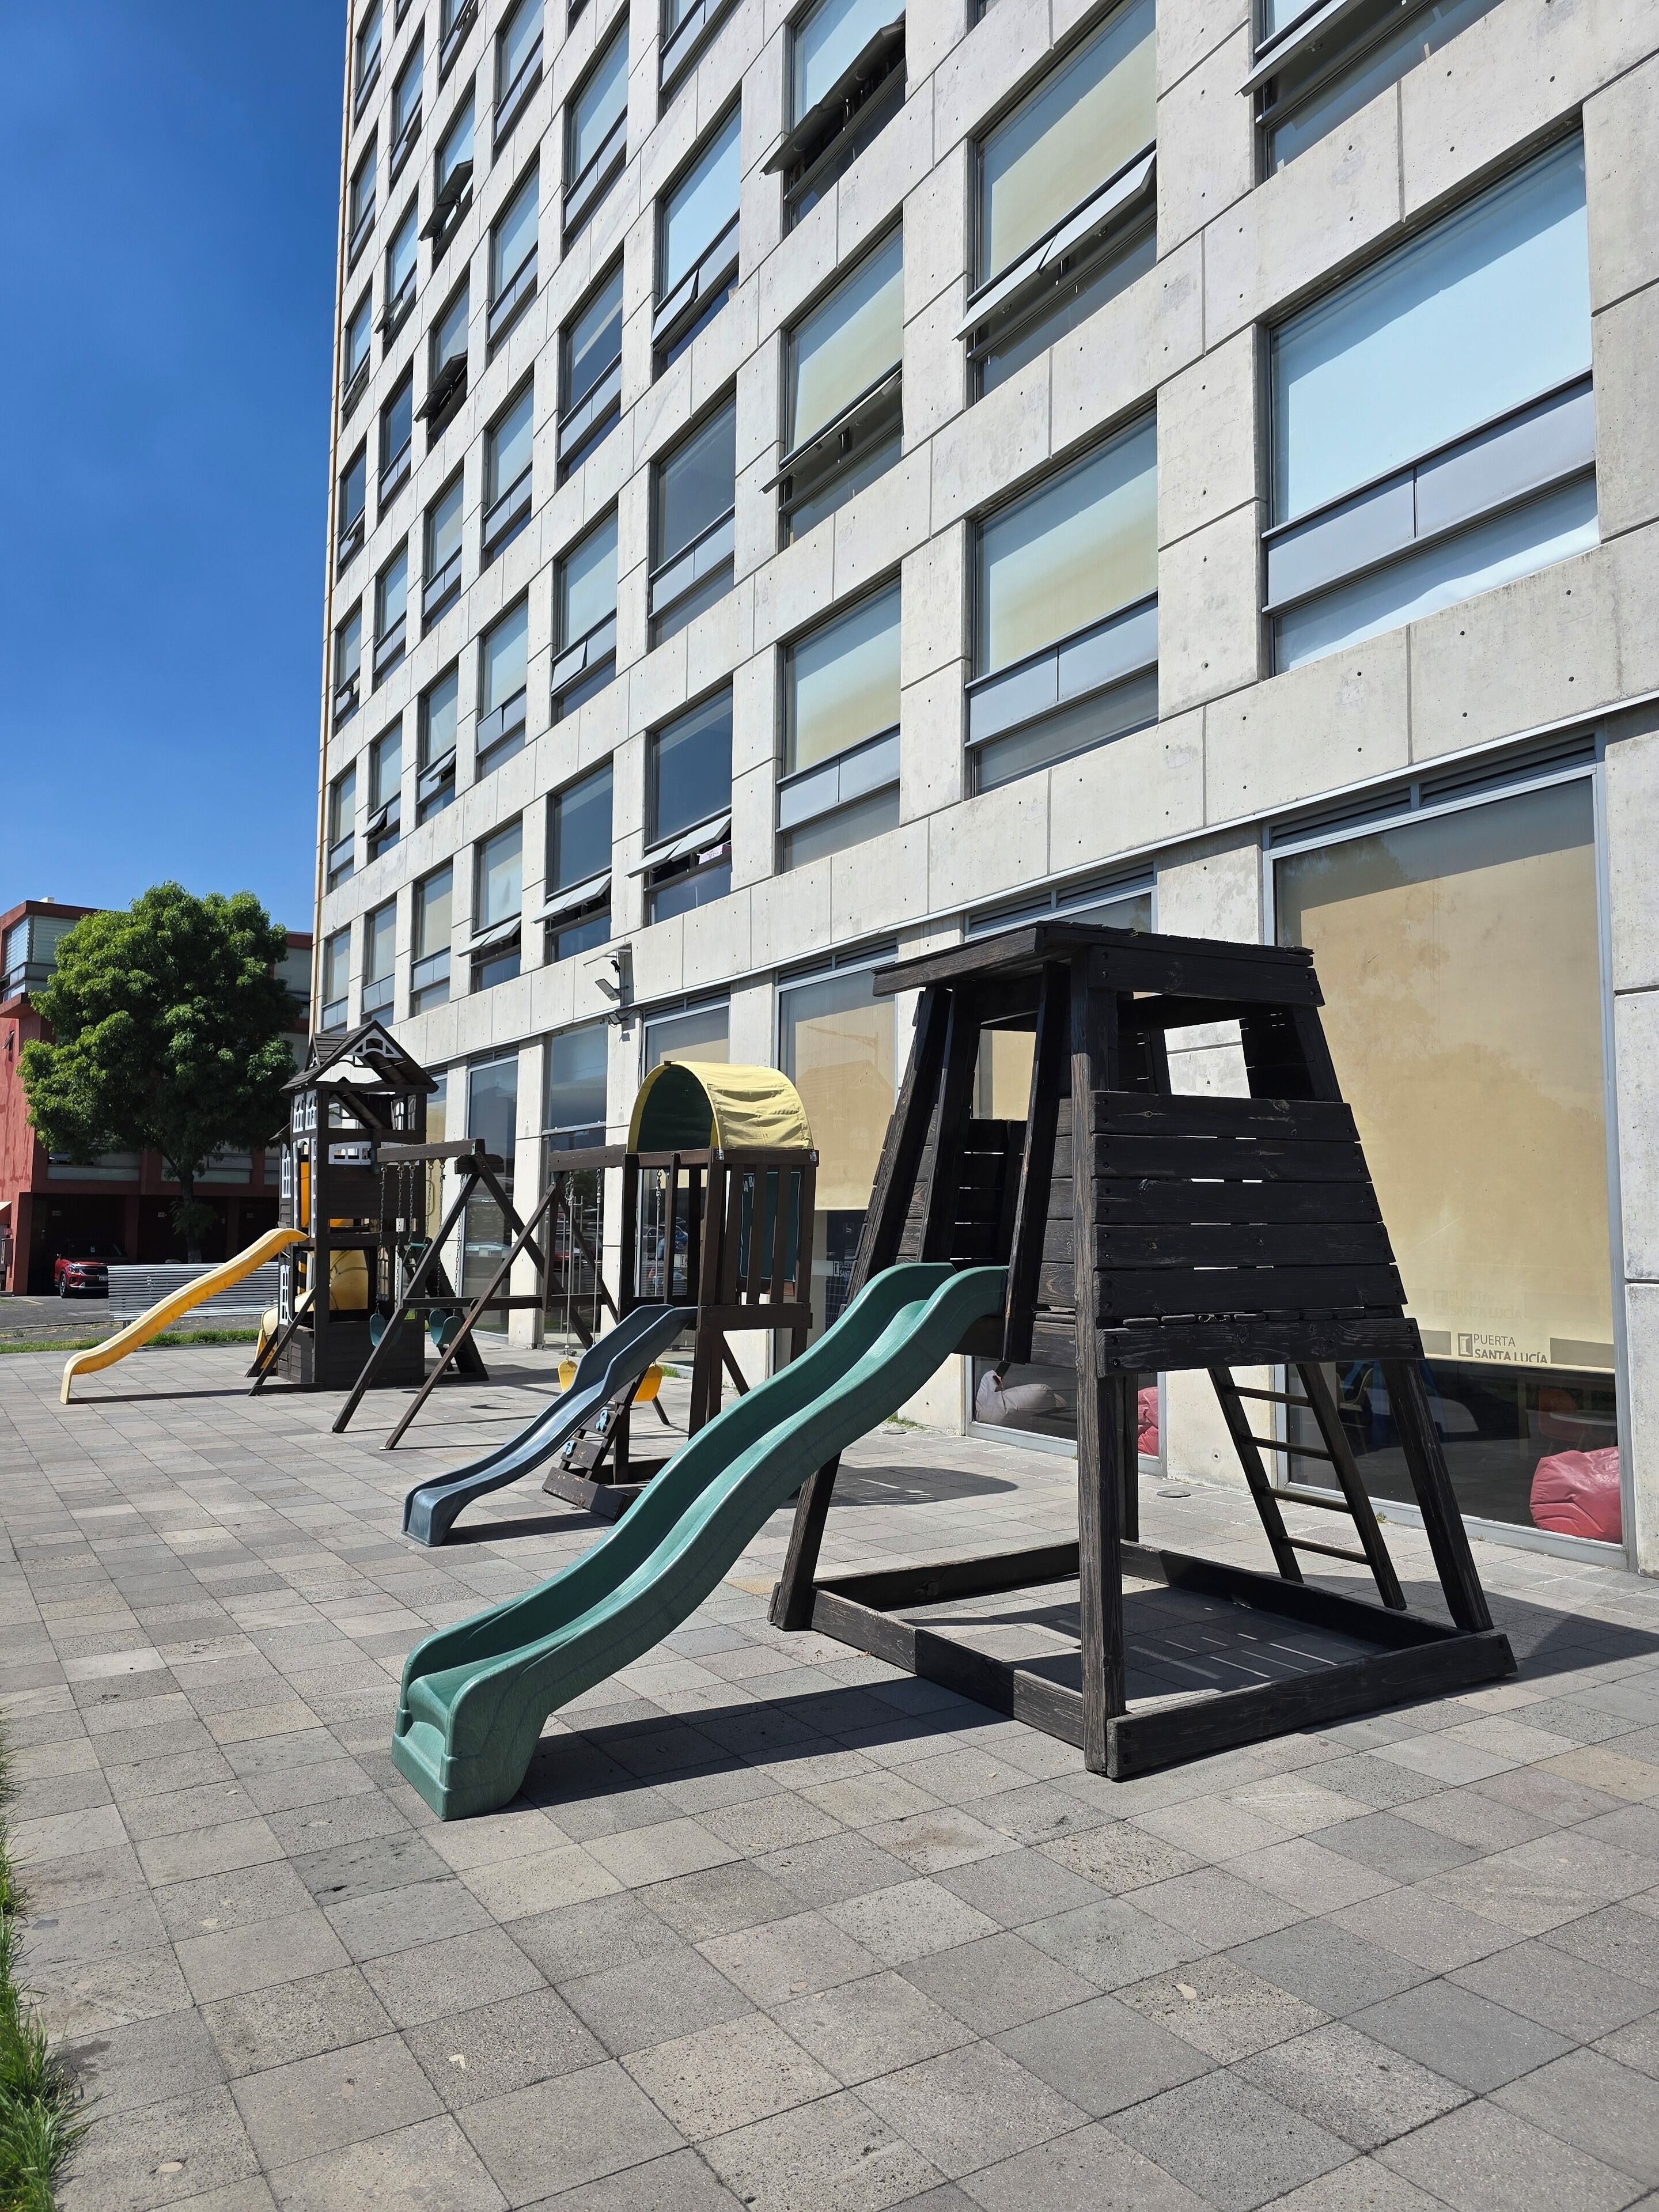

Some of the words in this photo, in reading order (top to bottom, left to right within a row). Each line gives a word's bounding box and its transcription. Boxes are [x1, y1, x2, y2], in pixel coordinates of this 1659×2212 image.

[1449, 1290, 1490, 1302] PUERTA
[1450, 1306, 1487, 1318] SANTA
[1474, 1334, 1516, 1347] PUERTA
[1475, 1349, 1512, 1361] SANTA
[1514, 1351, 1548, 1363] LUCÍA
